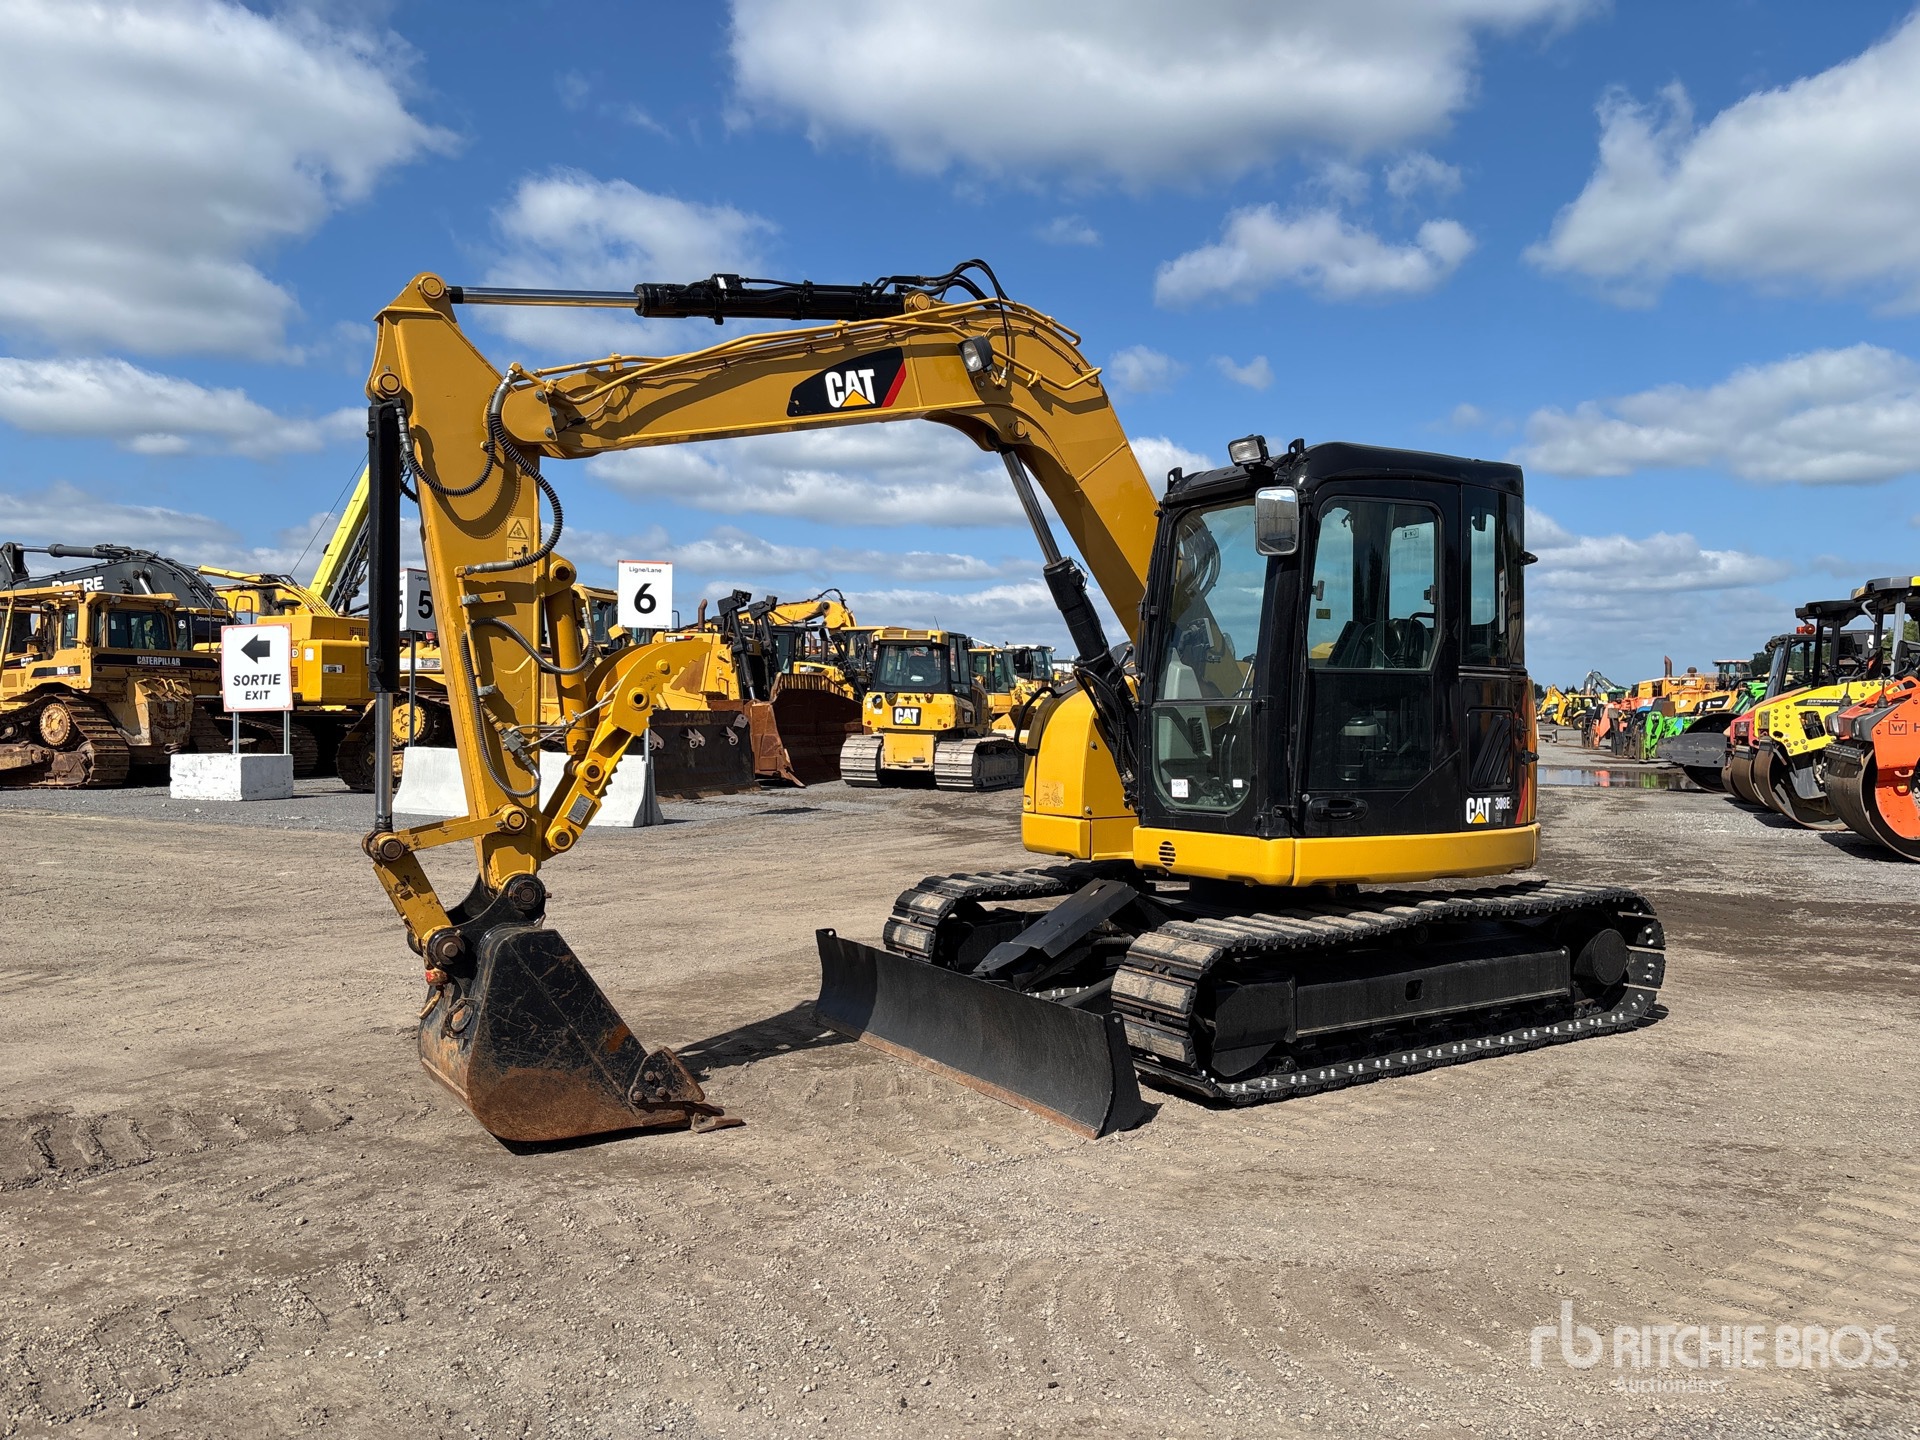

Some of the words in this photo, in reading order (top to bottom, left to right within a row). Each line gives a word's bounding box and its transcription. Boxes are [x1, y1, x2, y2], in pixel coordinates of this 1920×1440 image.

[825, 369, 876, 408] CAT
[418, 590, 433, 619] 5
[634, 583, 656, 614] 6
[136, 656, 181, 666] CATERPILLAR
[233, 674, 281, 686] SORTIE
[245, 690, 270, 700] EXIT
[895, 708, 919, 724] CAT
[1466, 797, 1491, 824] CAT
